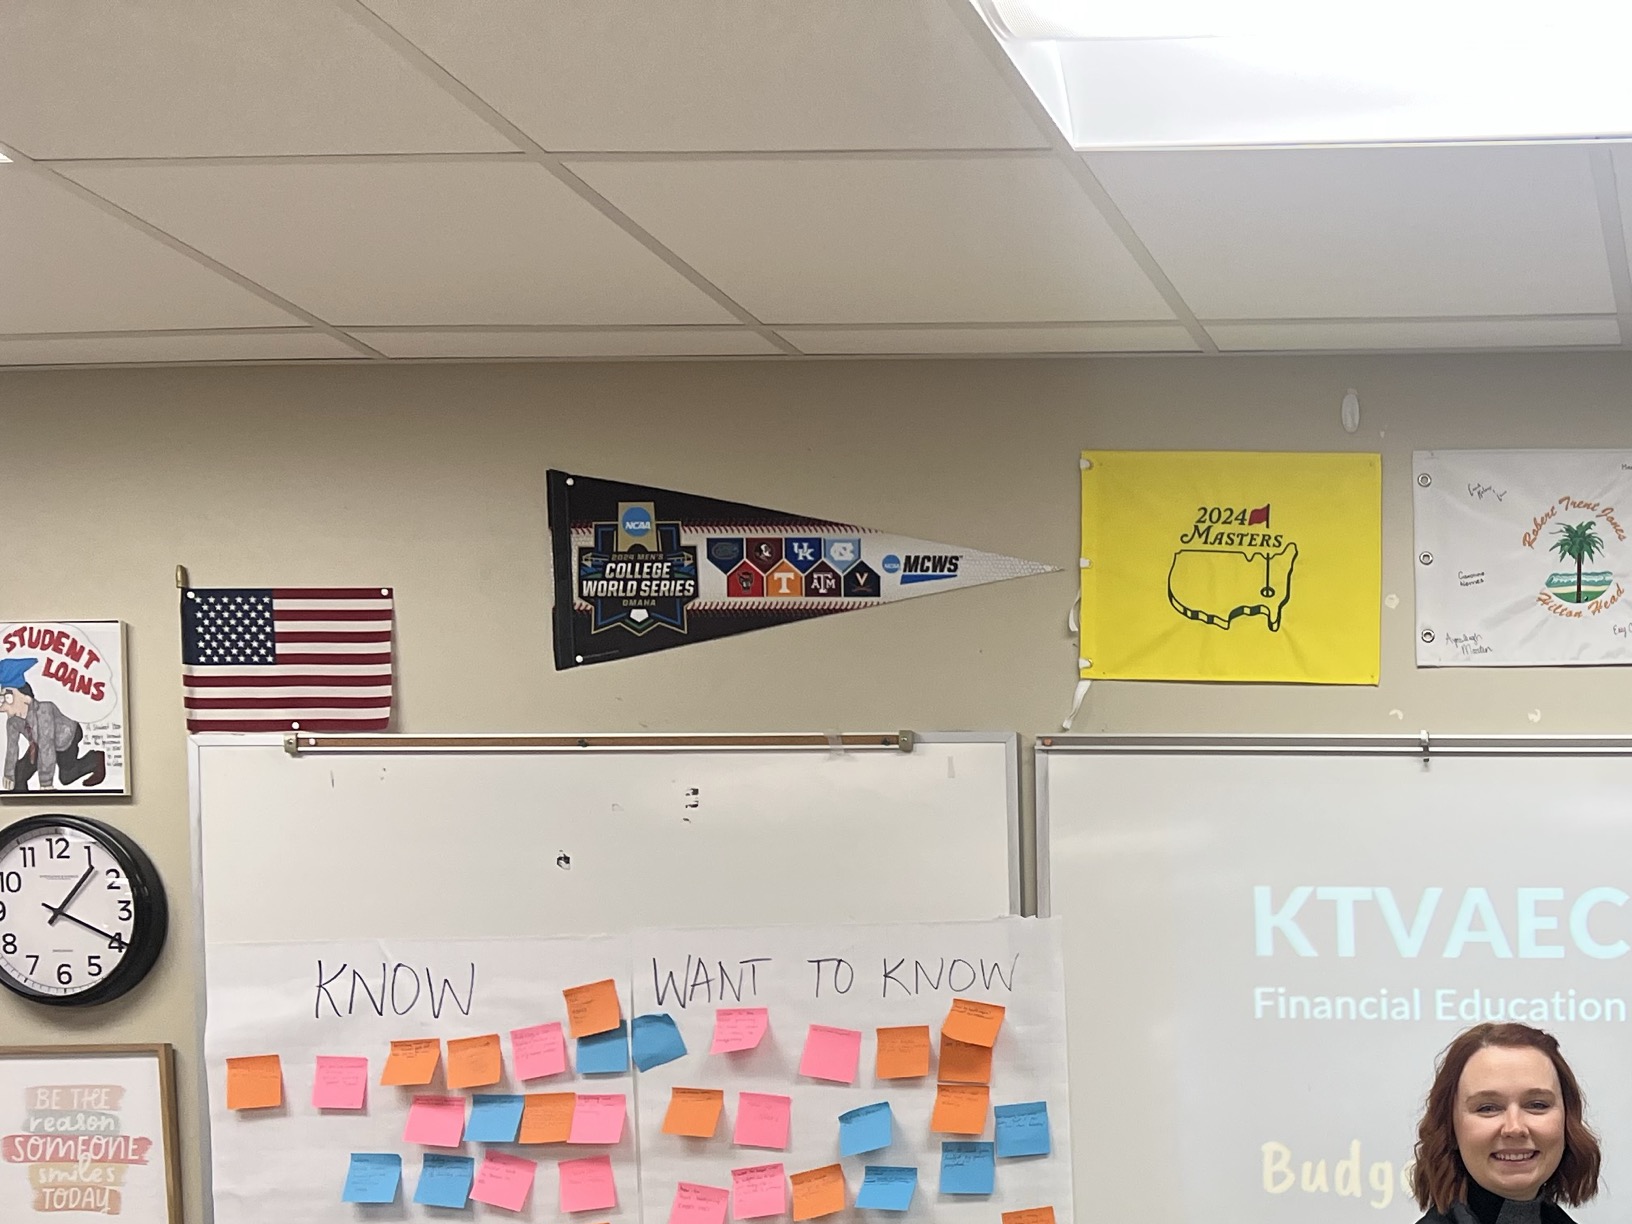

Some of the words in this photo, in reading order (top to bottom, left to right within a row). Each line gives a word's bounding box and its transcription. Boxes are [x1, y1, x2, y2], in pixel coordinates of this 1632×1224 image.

[625, 521, 651, 530] NCAA
[1195, 506, 1248, 526] 2024
[1522, 505, 1557, 550] Robert
[1558, 495, 1600, 512] Trent
[1595, 507, 1627, 542] Jones
[604, 562, 672, 579] COLLEGE
[903, 555, 960, 573] MCWS
[582, 580, 637, 597] WORLD
[639, 580, 695, 597] SERIES
[773, 572, 795, 594] T
[622, 599, 656, 607] OMAHA
[1536, 588, 1583, 618] Hilton
[1588, 582, 1625, 616] Head
[3, 626, 100, 670] STUDENT
[42, 657, 105, 701] LOANS
[20, 846, 36, 868] 11
[45, 838, 71, 859] 12
[83, 846, 92, 867] 1
[105, 868, 122, 890] 2
[118, 900, 133, 922] 3
[2, 933, 17, 955] 8
[108, 932, 125, 953] 4
[25, 954, 40, 976] 7
[57, 963, 72, 985] 6
[87, 955, 102, 977] 5
[314, 959, 475, 1020] KNOW
[653, 954, 771, 1009] WANT
[807, 957, 855, 998] TO
[882, 953, 1019, 998] KNOW
[1253, 986, 1421, 1022] Financial
[1435, 988, 1627, 1023] Education
[35, 1088, 62, 1109] BE
[70, 1087, 111, 1110] THE
[30, 1113, 115, 1132] reason
[11, 1136, 139, 1162] SOMEONE
[38, 1151, 115, 1183] smiles
[42, 1187, 110, 1214] TODAY
